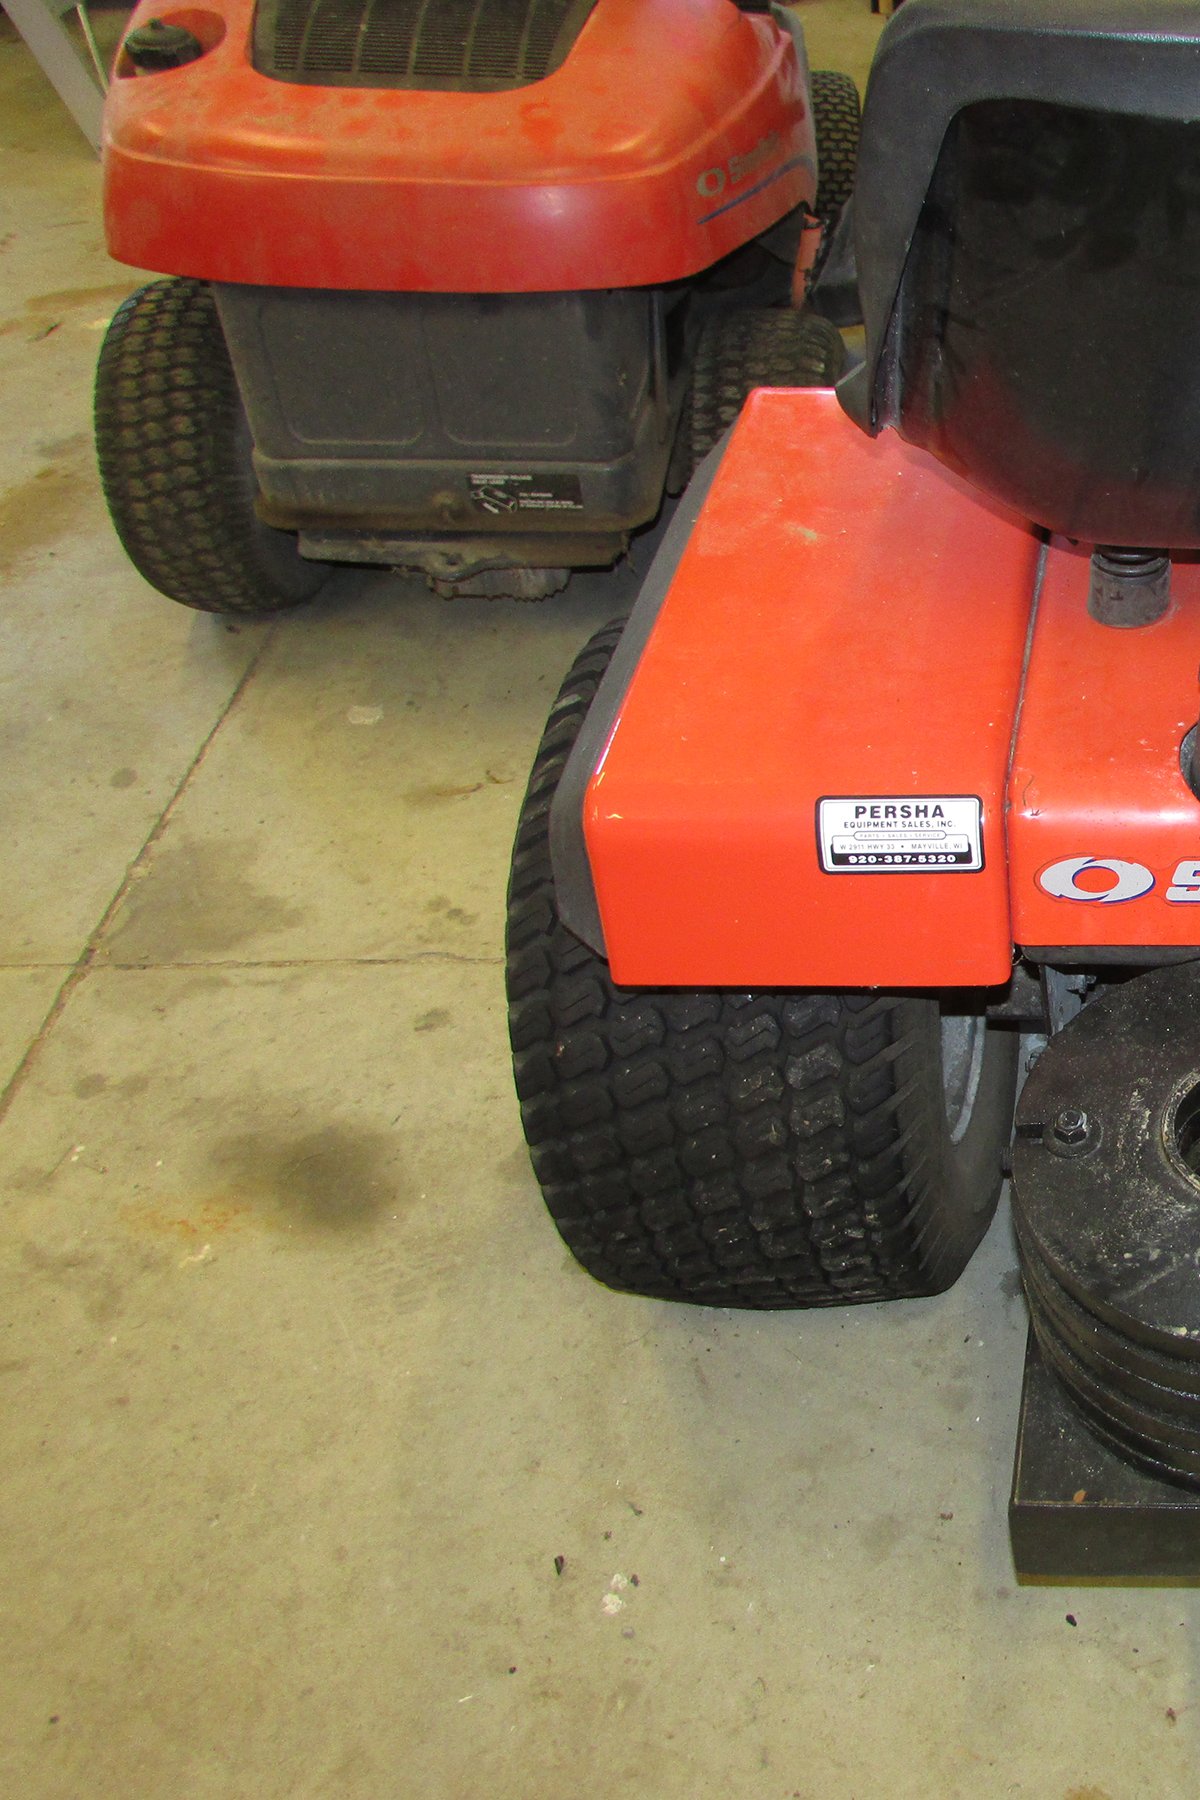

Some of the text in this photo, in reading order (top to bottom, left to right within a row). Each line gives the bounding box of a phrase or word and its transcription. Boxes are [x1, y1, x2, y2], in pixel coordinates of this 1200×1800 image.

[854, 805, 945, 819] PERSHA
[844, 820, 957, 829] EQUIPMENT SALES, INC.
[848, 854, 957, 864] 920-387-5320
